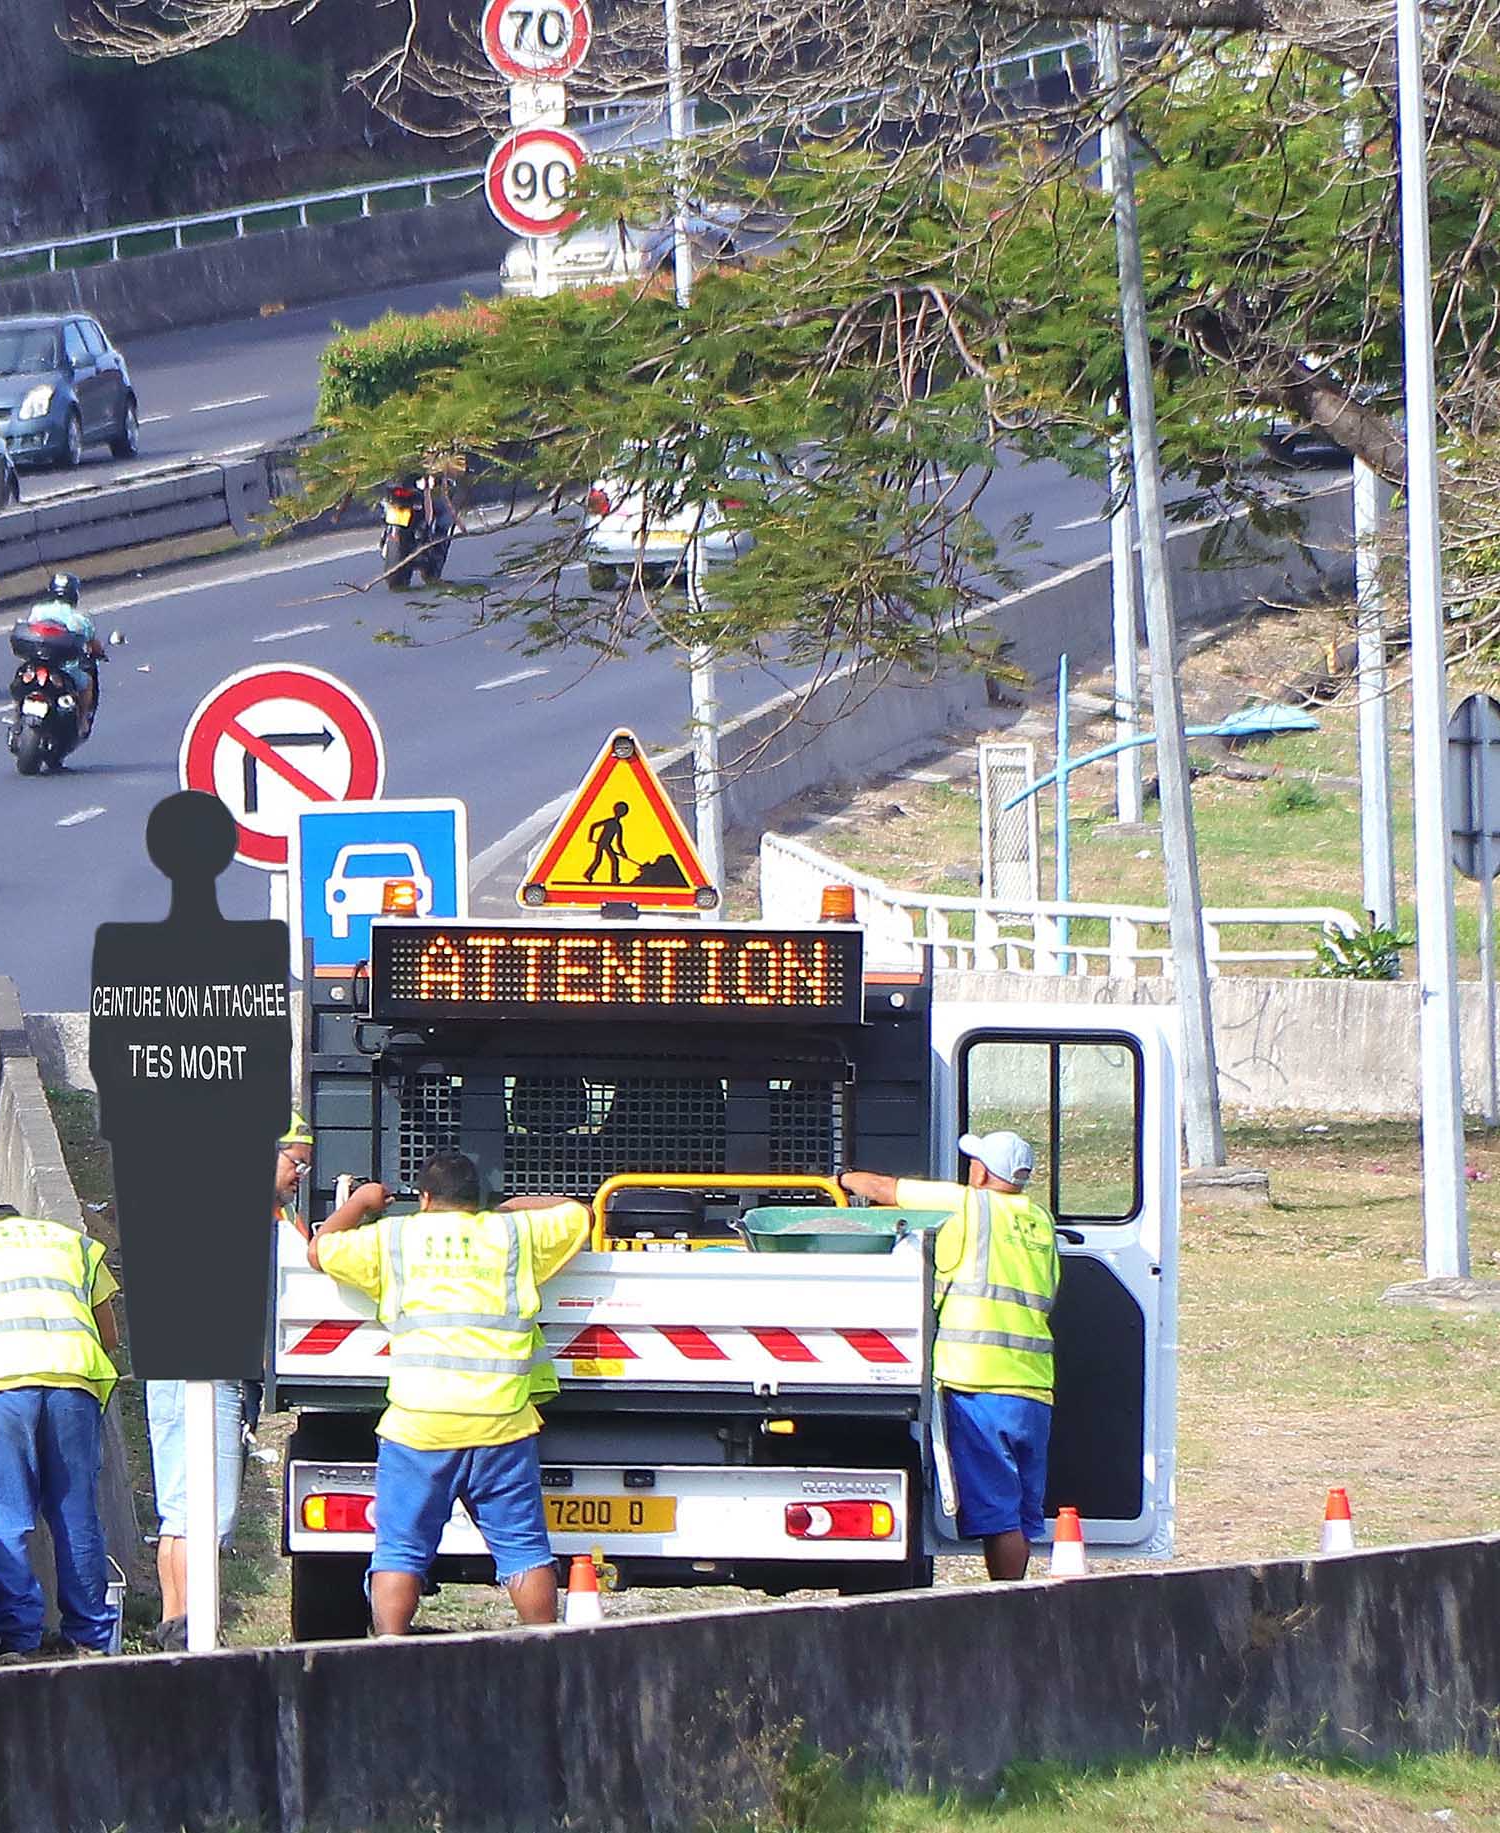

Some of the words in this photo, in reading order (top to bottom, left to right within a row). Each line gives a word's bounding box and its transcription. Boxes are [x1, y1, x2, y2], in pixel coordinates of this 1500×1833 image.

[508, 9, 566, 49] 70
[512, 160, 571, 201] 90
[419, 936, 825, 1006] ATTENTION
[92, 985, 162, 1018] CEINTURE
[166, 985, 198, 1018] NON
[203, 983, 287, 1018] ATTACHEE
[128, 1044, 174, 1079] T'ES
[180, 1045, 247, 1080] MORT
[801, 1480, 891, 1494] RENAULT
[550, 1500, 611, 1525] 7200
